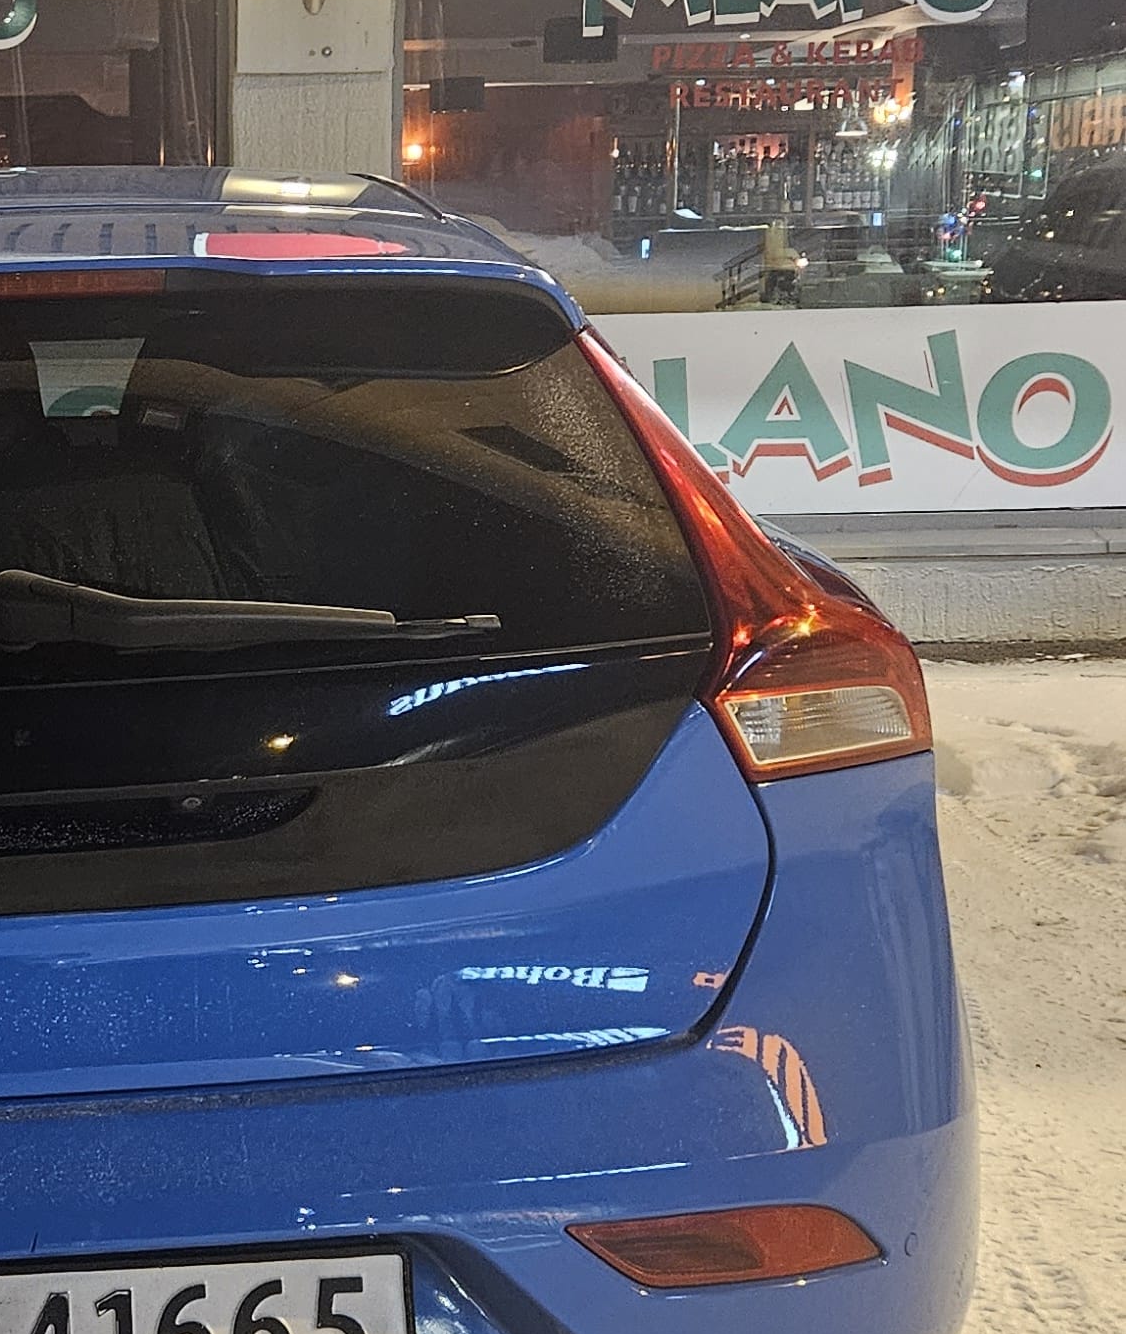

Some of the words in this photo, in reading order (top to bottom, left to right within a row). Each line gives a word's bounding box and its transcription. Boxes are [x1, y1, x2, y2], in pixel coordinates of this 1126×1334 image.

[651, 42, 756, 69] PIZZA
[770, 42, 793, 66] &
[806, 38, 926, 65] KEBAB
[668, 77, 905, 110] RESTAURANT
[619, 330, 1114, 488] LANO
